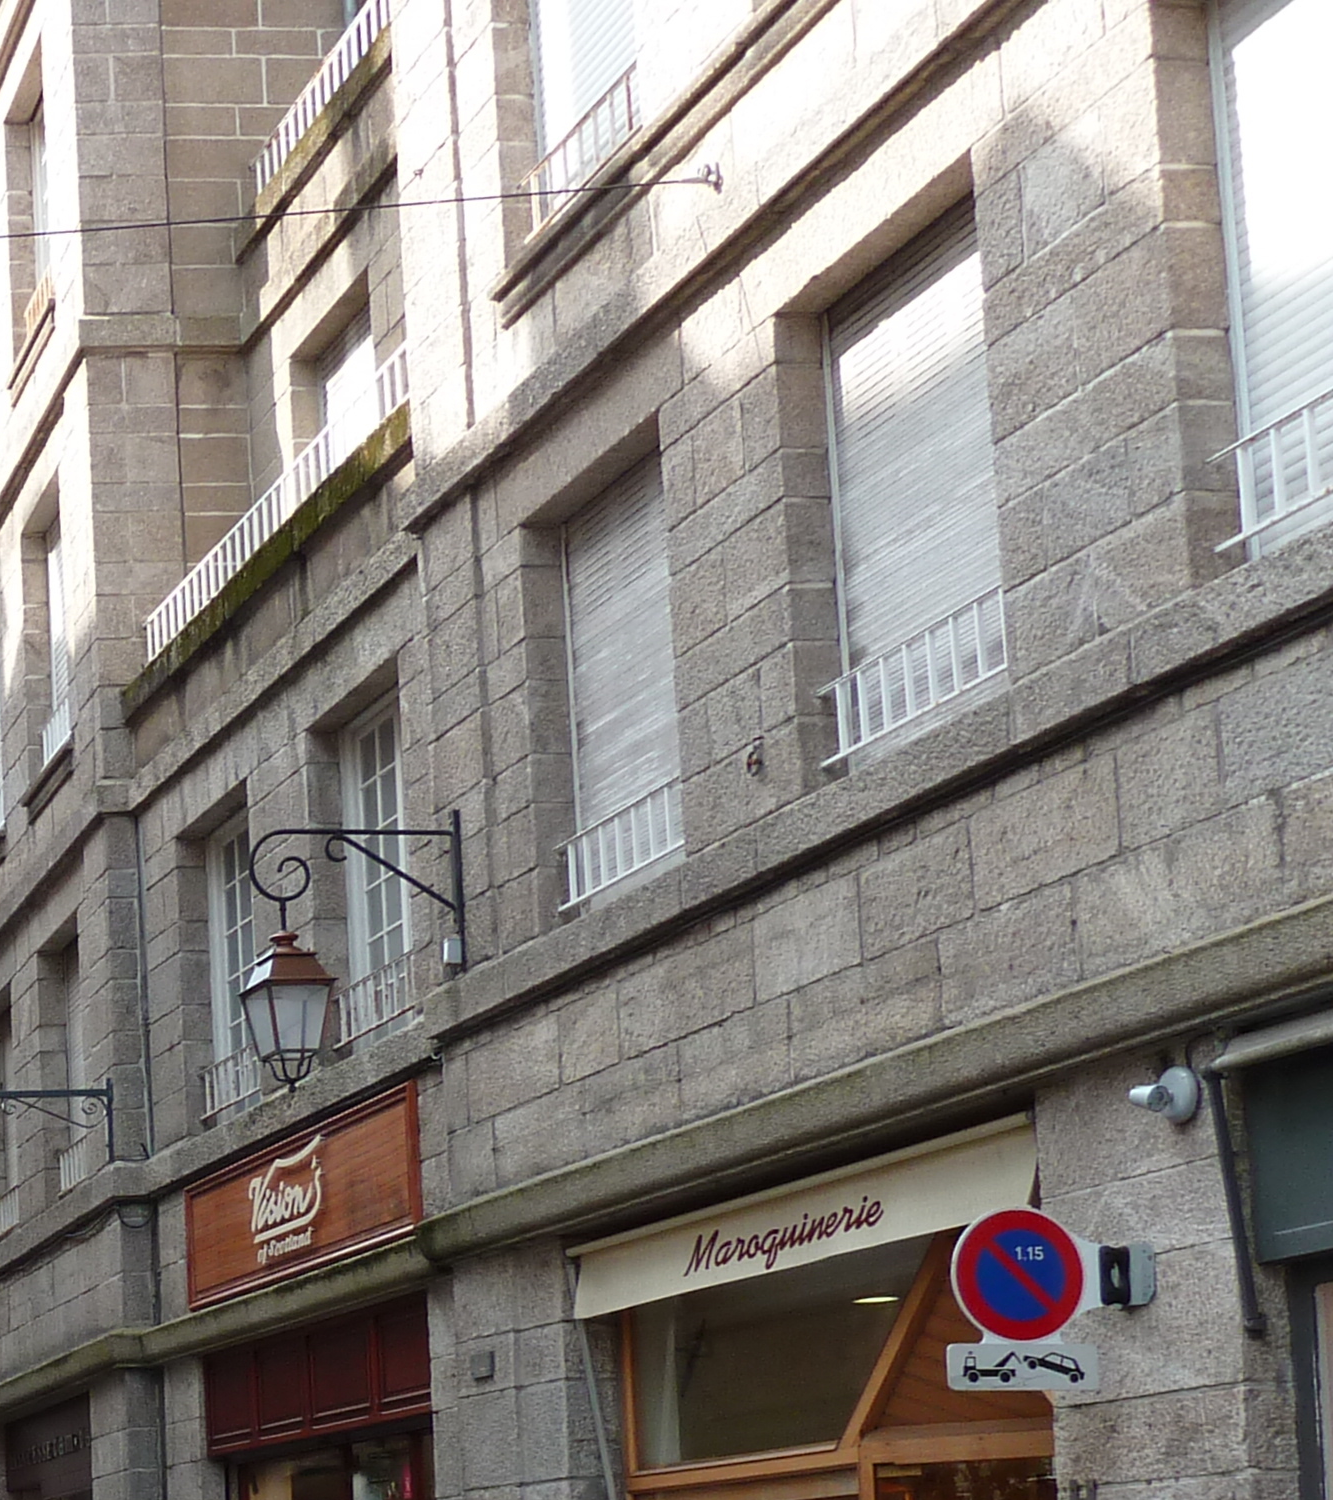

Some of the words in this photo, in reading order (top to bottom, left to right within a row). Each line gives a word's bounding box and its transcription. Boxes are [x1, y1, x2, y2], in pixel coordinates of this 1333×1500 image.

[257, 1243, 267, 1265] of
[268, 1226, 314, 1257] Scotland
[683, 1195, 884, 1278] Maroquinerie
